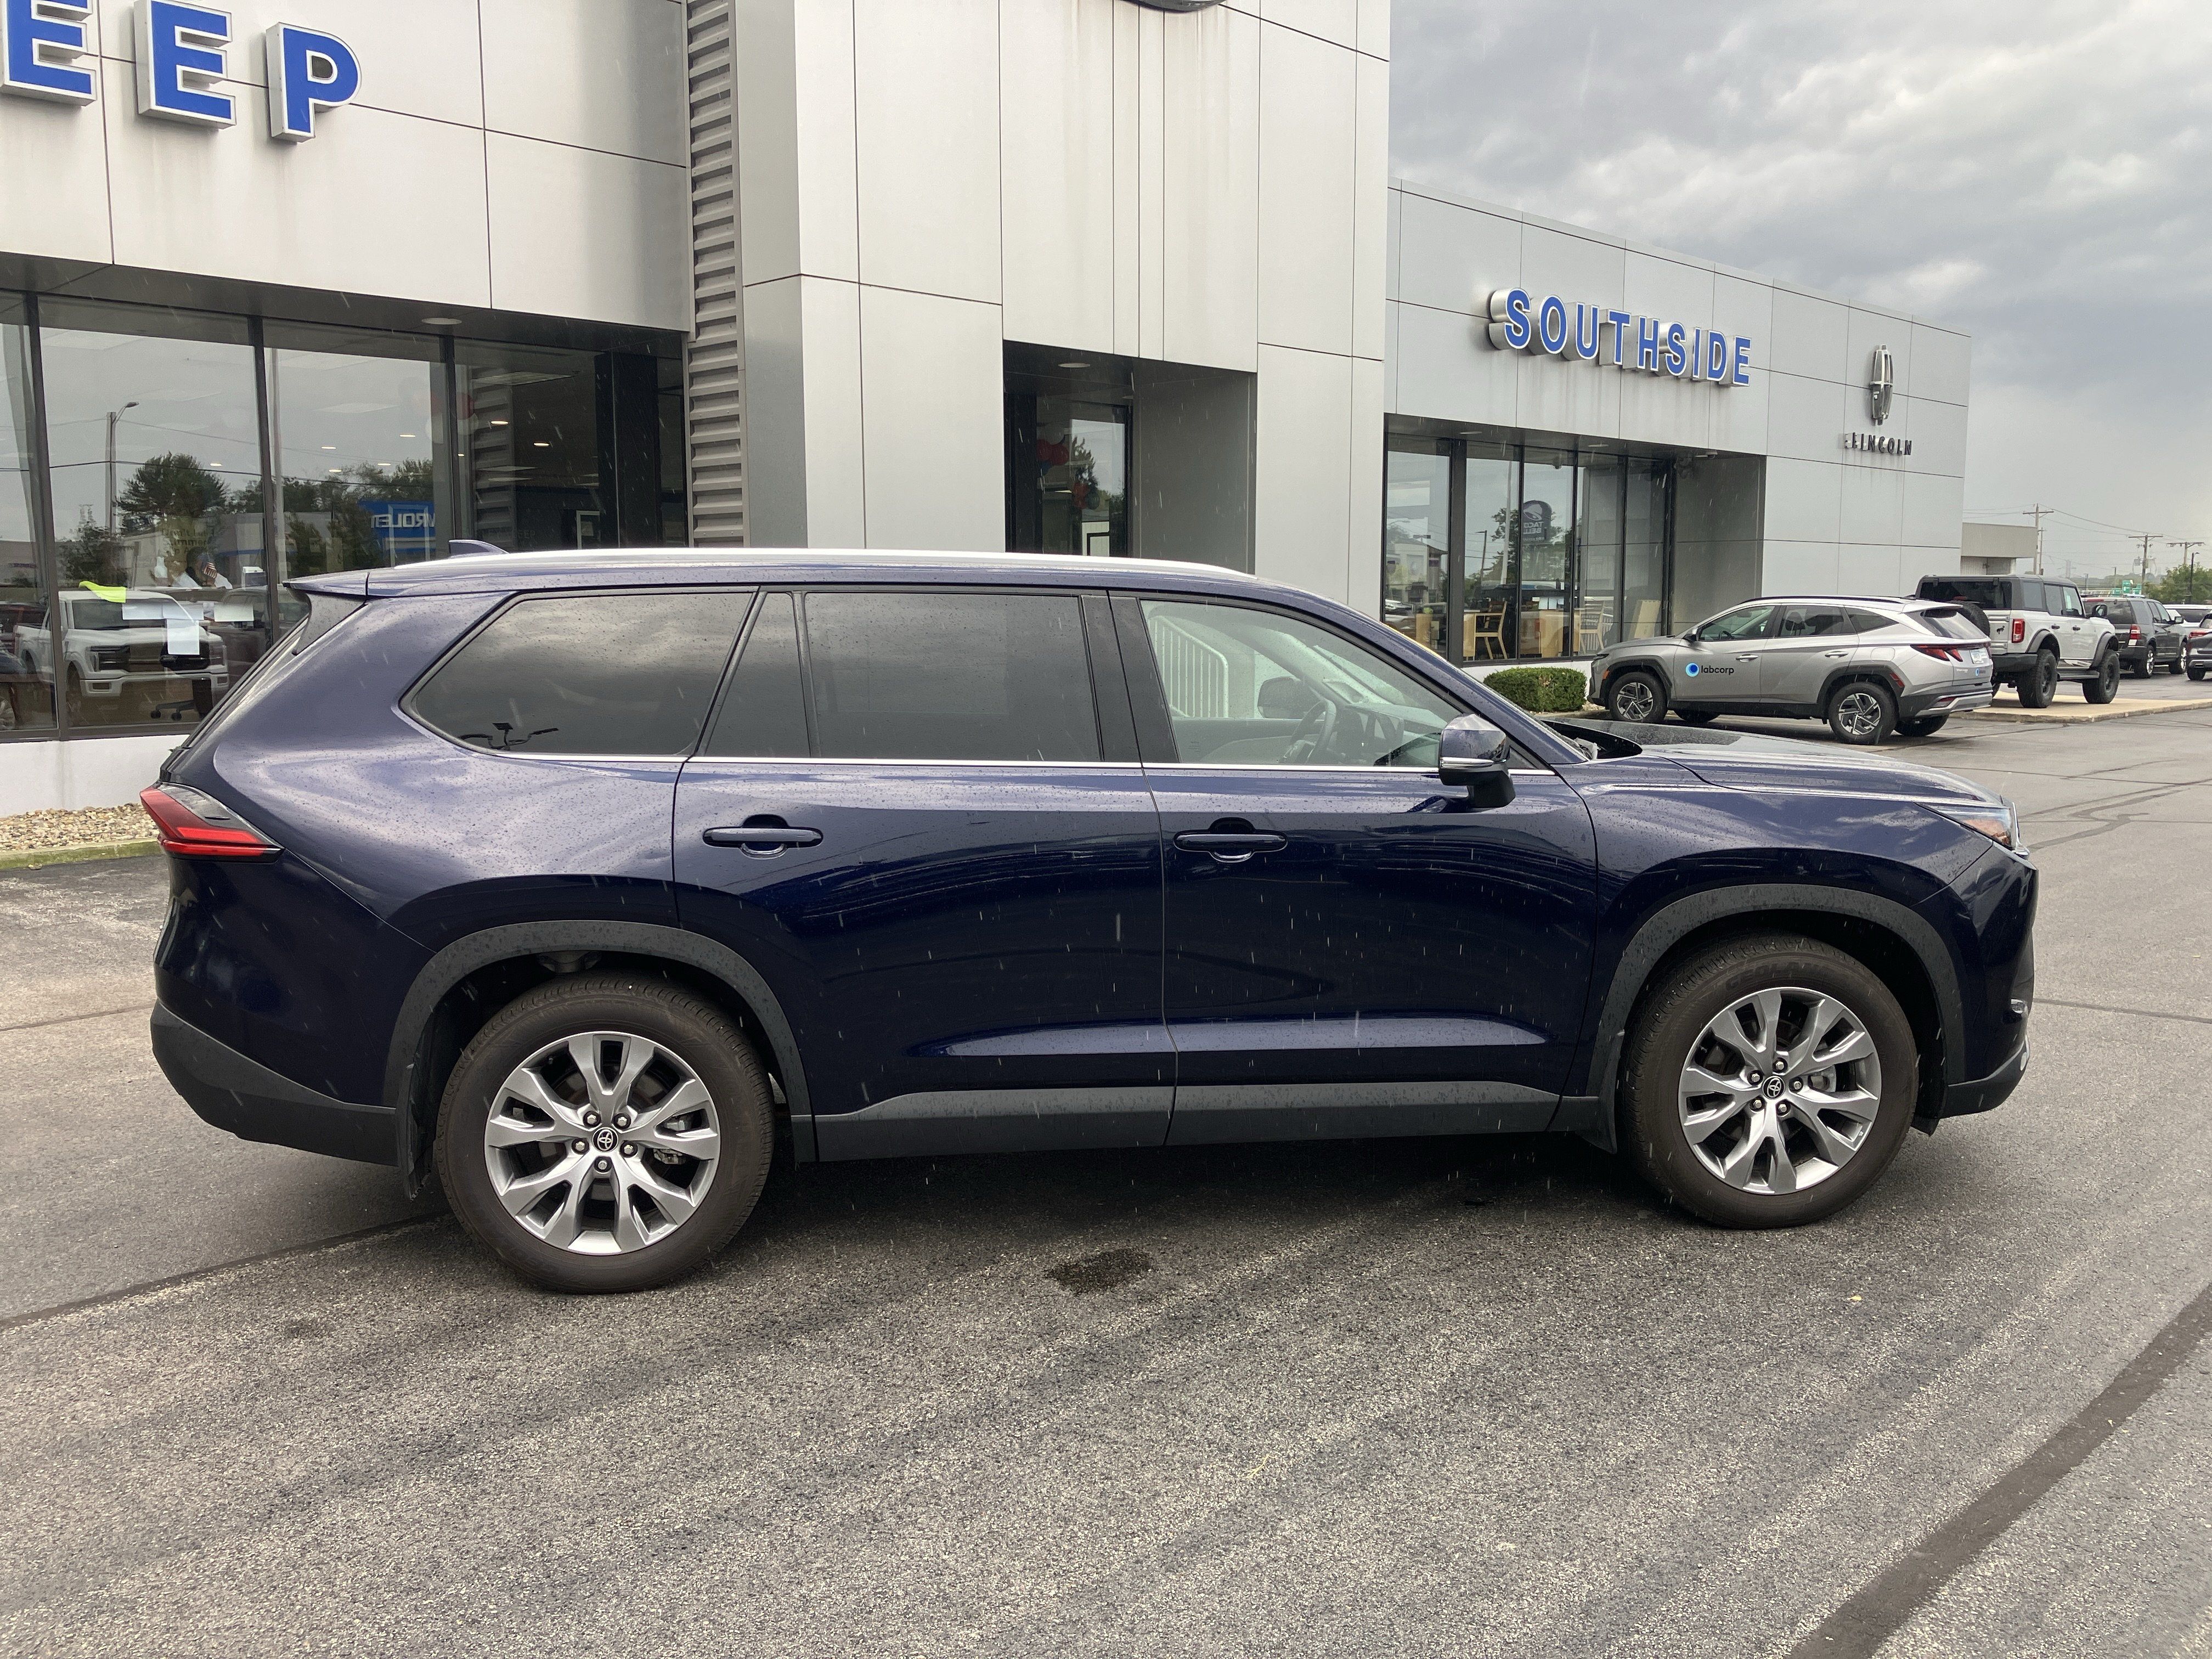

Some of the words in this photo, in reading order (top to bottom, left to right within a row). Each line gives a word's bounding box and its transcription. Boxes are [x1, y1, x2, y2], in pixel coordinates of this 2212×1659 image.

[1491, 287, 1752, 386] SOUTHSIDE
[1849, 432, 1912, 455] LINCOLN
[1701, 665, 1734, 675] labcorp
